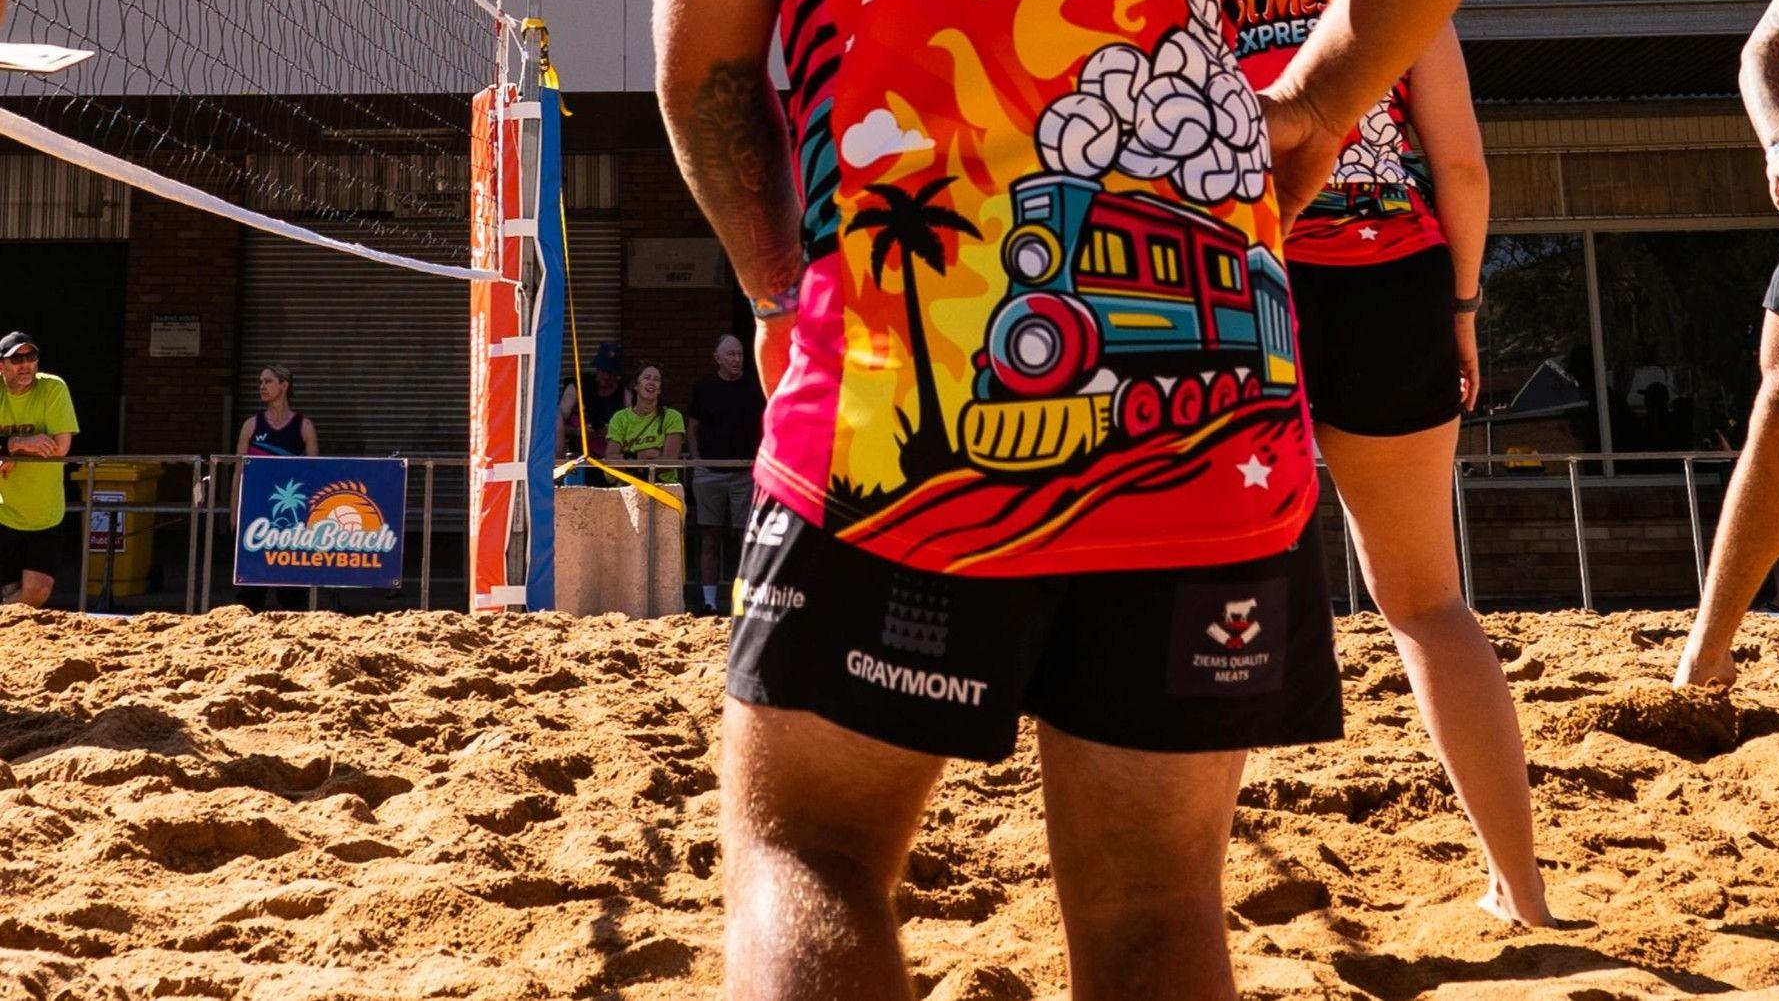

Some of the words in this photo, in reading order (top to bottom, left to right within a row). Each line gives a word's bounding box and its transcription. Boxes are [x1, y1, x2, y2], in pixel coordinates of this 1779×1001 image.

[1235, 18, 1319, 56] XPRE
[1229, 652, 1270, 669] QUALITY
[846, 649, 988, 707] GRAYMONT
[1214, 669, 1250, 682] MEATS
